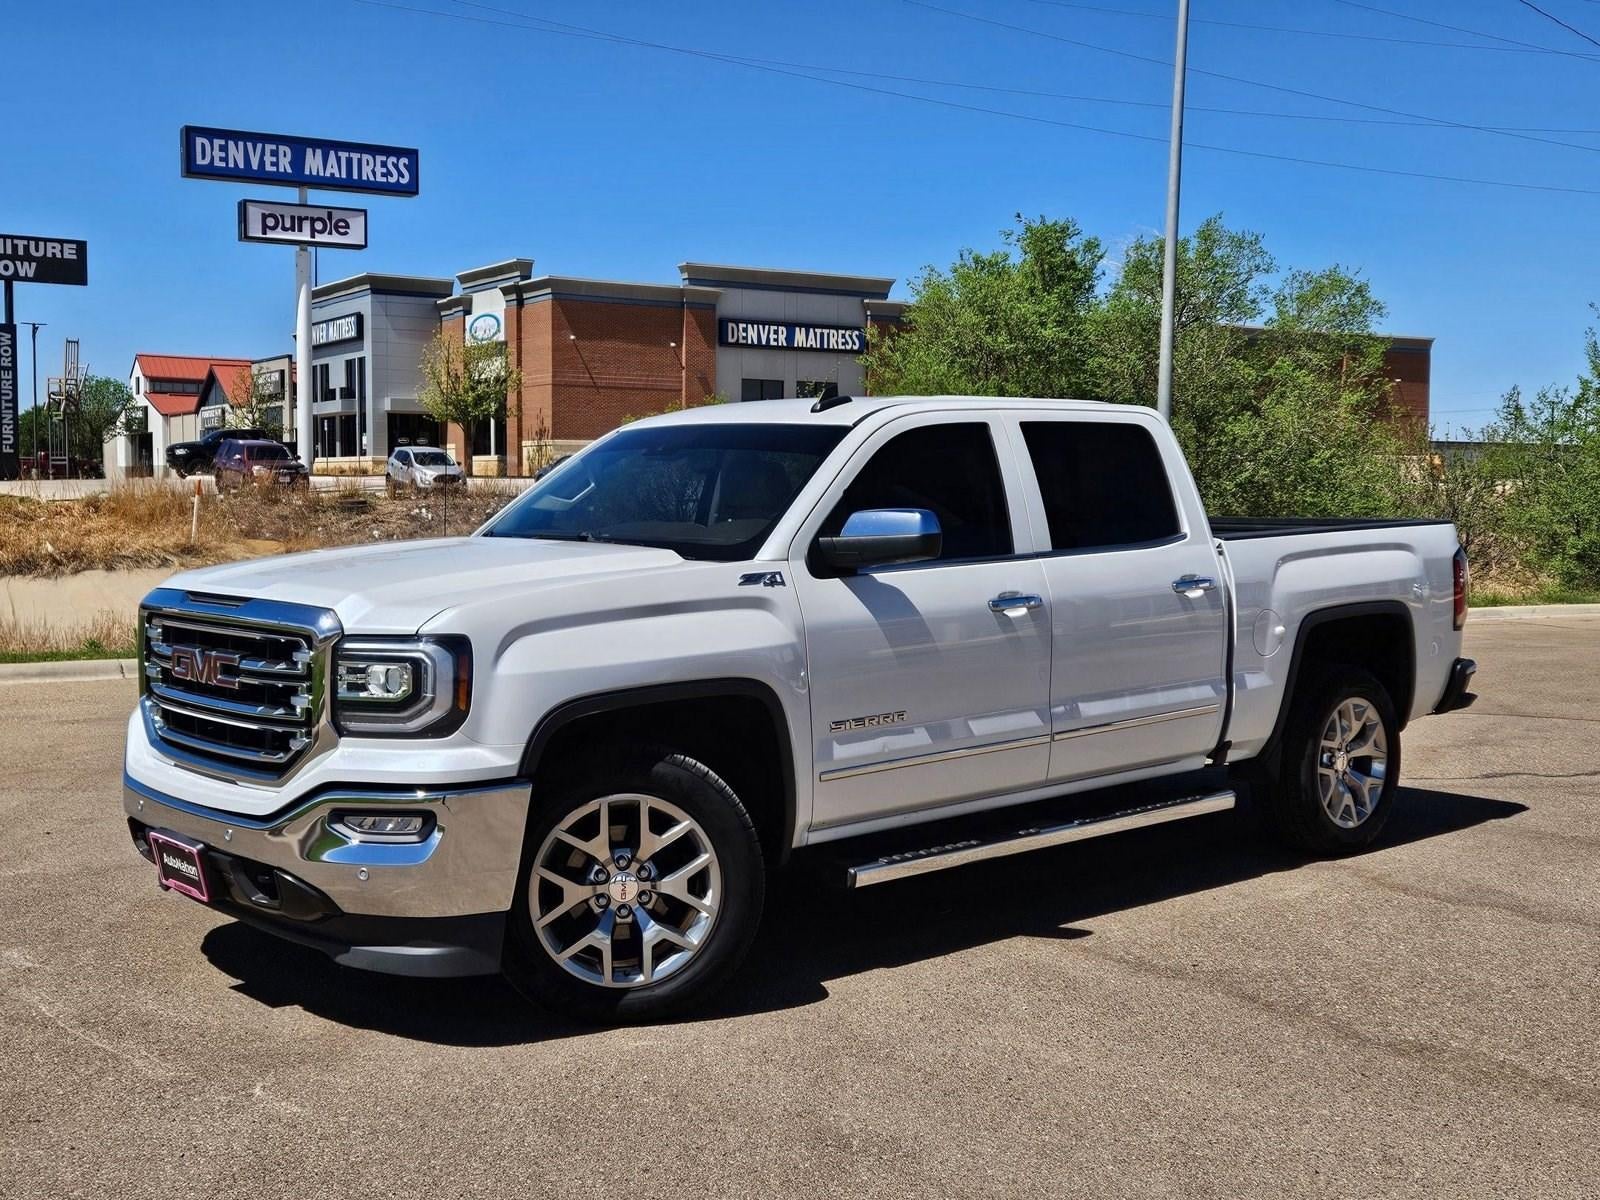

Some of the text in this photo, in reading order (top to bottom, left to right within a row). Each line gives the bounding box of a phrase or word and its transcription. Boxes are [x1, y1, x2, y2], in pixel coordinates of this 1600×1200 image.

[195, 136, 411, 185] DENVER MATTRESS
[261, 210, 351, 239] purple
[328, 315, 356, 343] MATTRESS
[727, 321, 860, 351] DENVER MATTRESS
[1, 331, 14, 454] FURNITURE ROW
[171, 644, 241, 690] GMC
[830, 709, 908, 733] SIERRA
[163, 851, 199, 877] AutoNation
